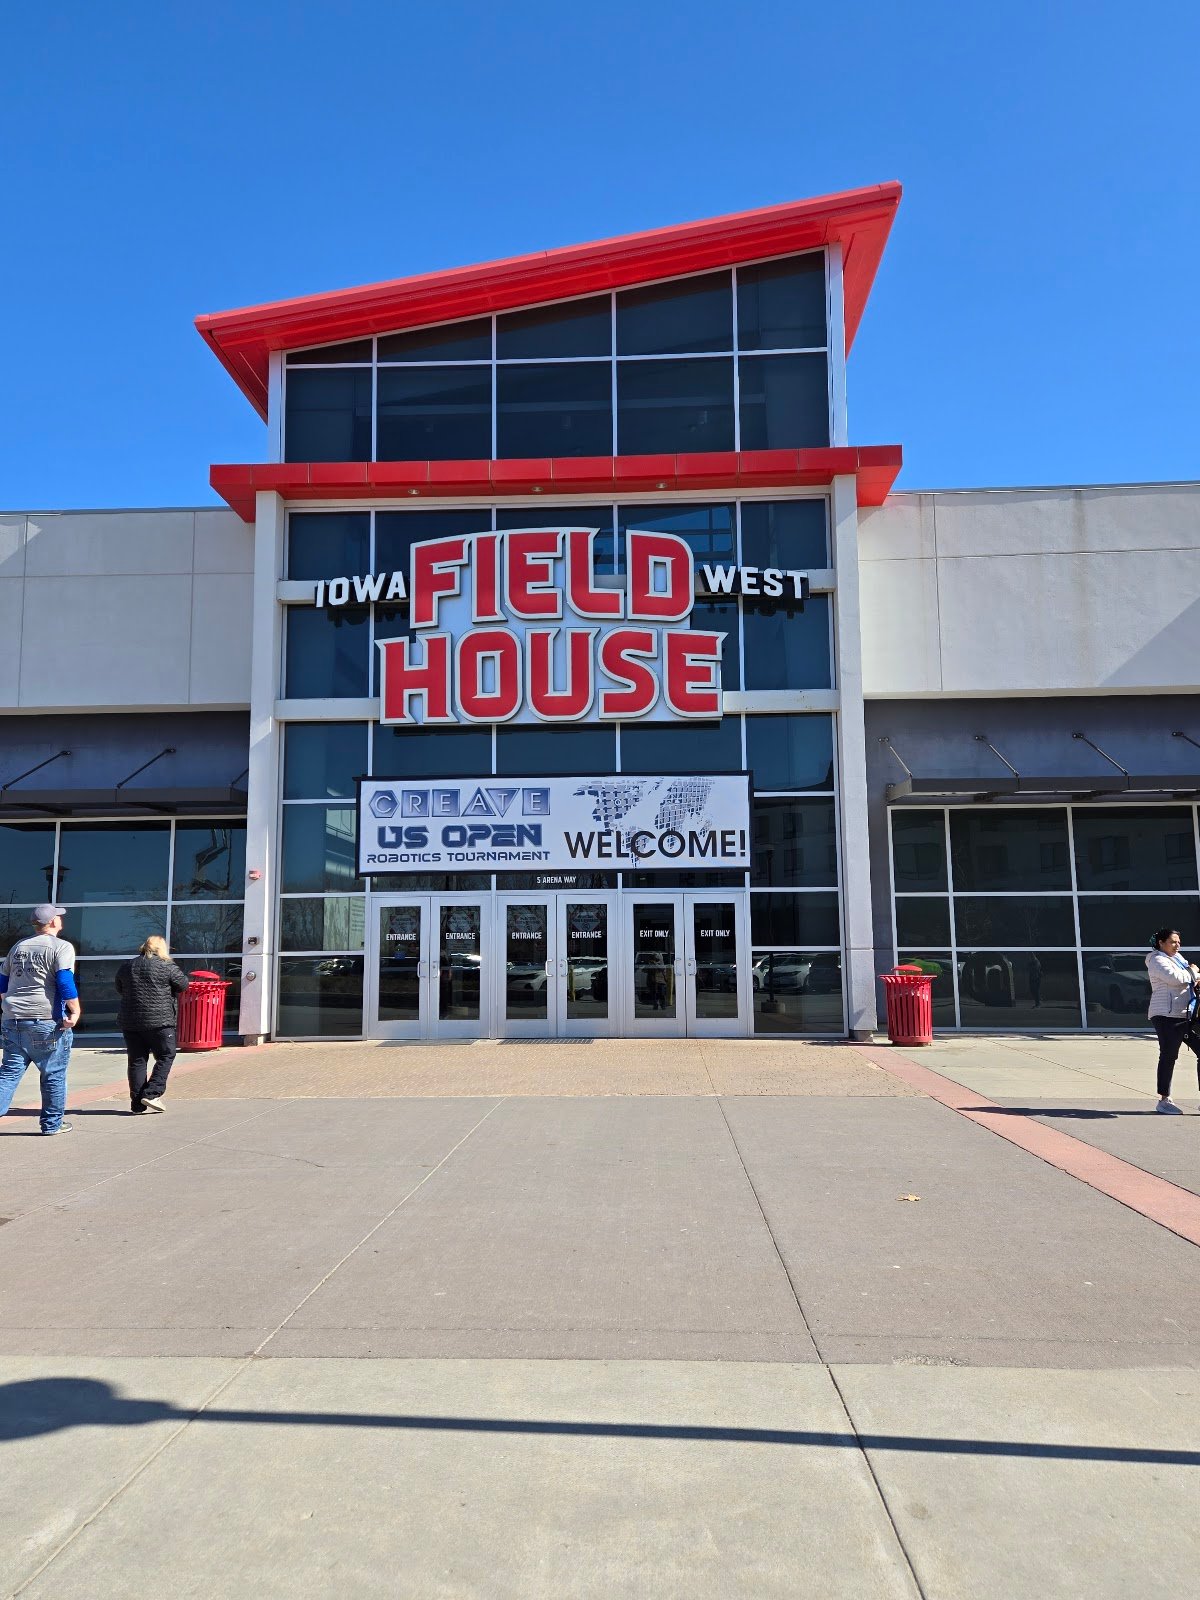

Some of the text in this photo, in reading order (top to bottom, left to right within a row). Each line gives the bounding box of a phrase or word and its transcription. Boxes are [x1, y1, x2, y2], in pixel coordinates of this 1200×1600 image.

[410, 527, 695, 629] FIELD
[703, 564, 809, 599] WEST
[315, 571, 407, 608] IOWA
[374, 626, 728, 725] HOUSE
[372, 790, 547, 815] CREATE
[377, 823, 543, 849] US OPEN
[564, 830, 746, 858] WELCOME!
[367, 851, 550, 864] ROBOTICS TOURNAMENT
[542, 876, 562, 884] ARENA
[563, 875, 577, 884] WAY
[386, 933, 416, 941] ENTRANCE
[445, 932, 476, 940] ENTRANCE
[512, 932, 542, 940] ENTRANCE
[571, 931, 602, 939] ENTRANCE
[639, 930, 669, 938] EXIT ONLY
[700, 929, 730, 937] EXIT ONLY
